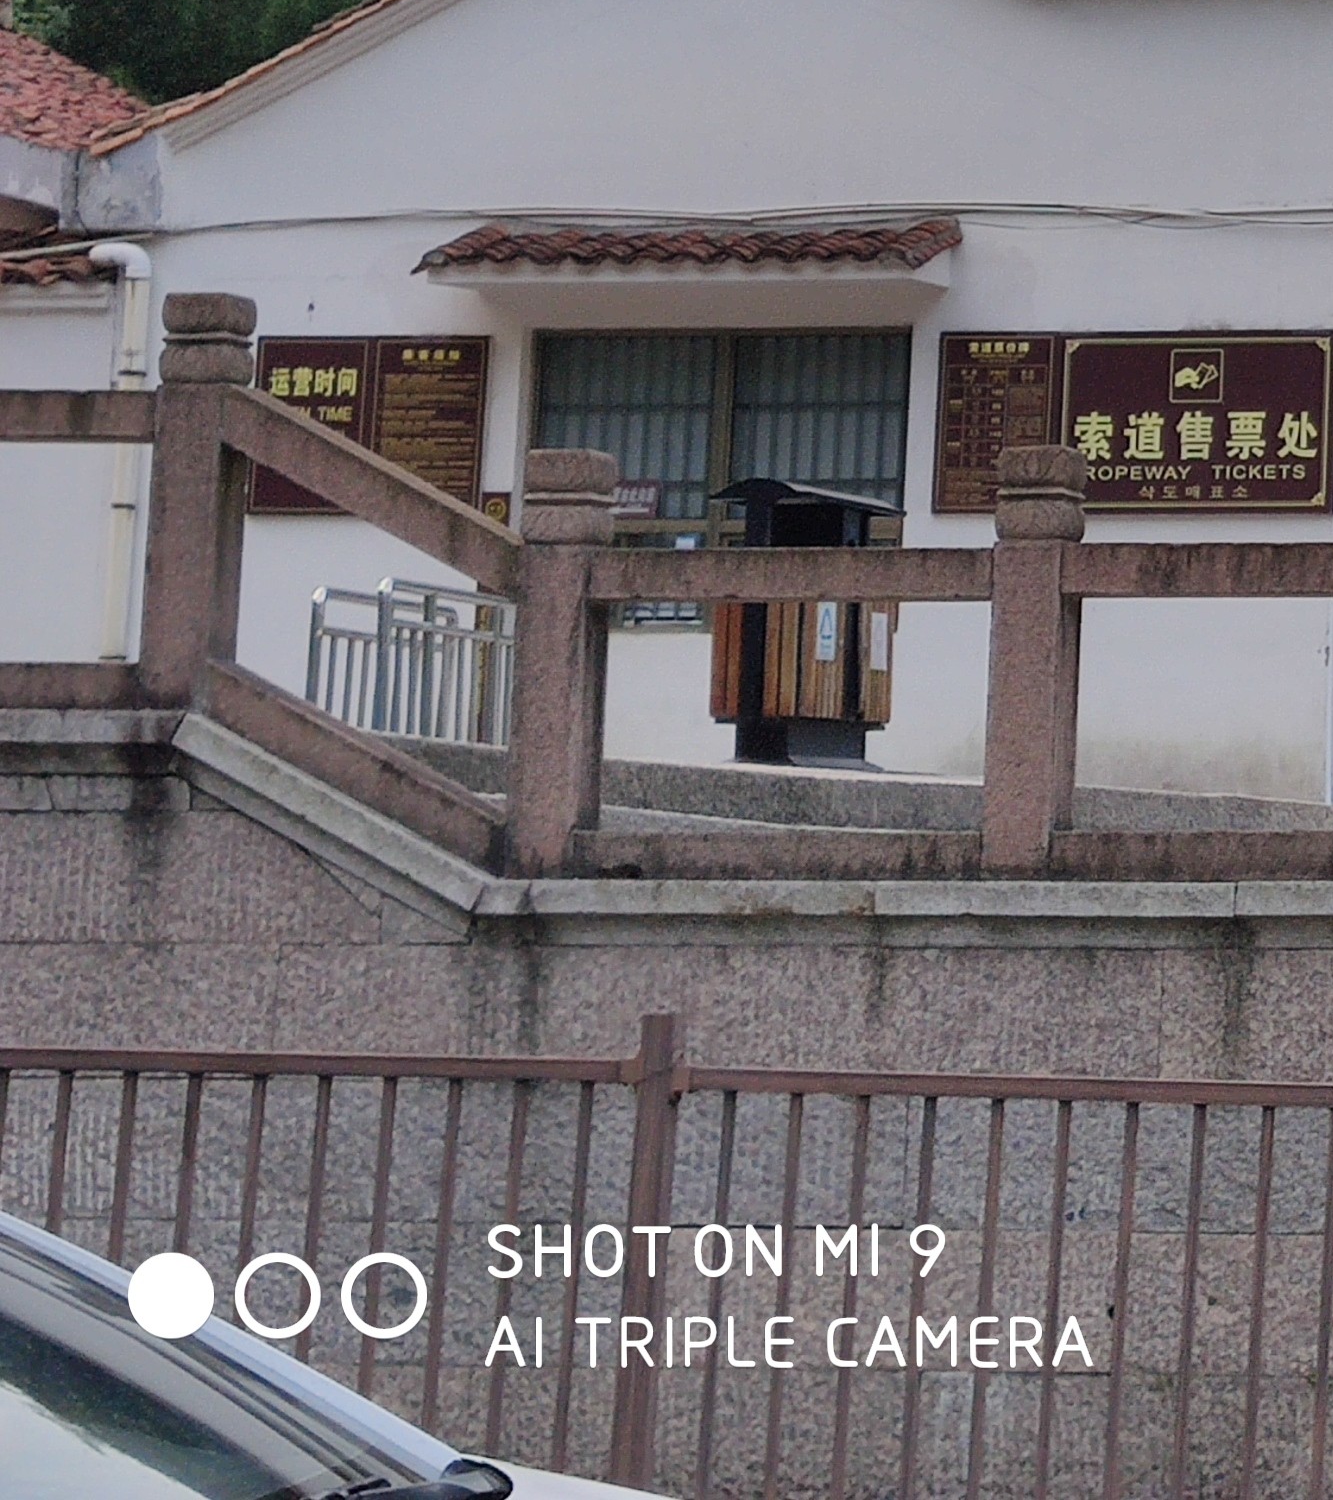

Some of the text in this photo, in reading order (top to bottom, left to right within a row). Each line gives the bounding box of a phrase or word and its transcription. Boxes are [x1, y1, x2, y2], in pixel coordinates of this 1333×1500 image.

[270, 367, 358, 397] 运营时间
[319, 406, 353, 422] TIME
[1073, 410, 1318, 461] 索道售票处
[1086, 464, 1306, 481] ROPEWAY TICKETS
